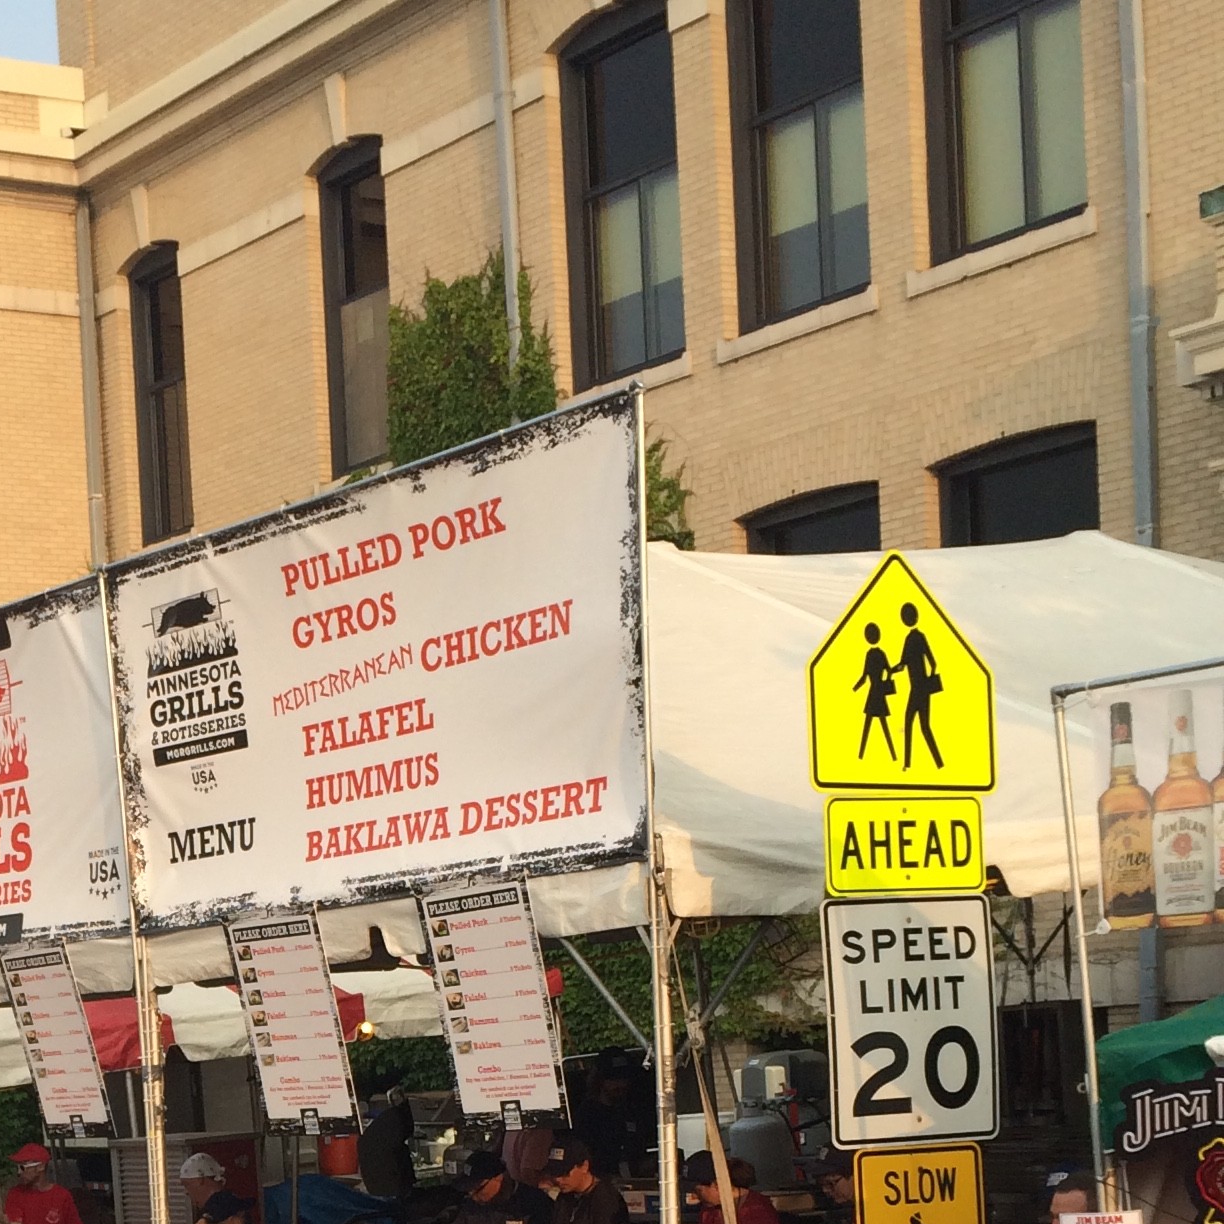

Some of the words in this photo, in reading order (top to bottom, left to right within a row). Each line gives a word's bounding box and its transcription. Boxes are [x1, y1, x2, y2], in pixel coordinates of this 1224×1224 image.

[281, 532, 403, 597] PULLED
[408, 497, 507, 559] PORK
[292, 592, 397, 649] GYROS
[146, 659, 241, 699] MINNESOTA
[272, 643, 414, 717] MEDITERRANEAN
[420, 599, 574, 673] CHICKEN
[150, 681, 245, 728] GRILLS
[151, 731, 159, 746] &
[161, 712, 247, 745] ROTISSERIES
[166, 736, 235, 761] MGRGRILLS.COM
[302, 698, 434, 757] FALAFEL
[192, 769, 216, 785] USA
[306, 752, 440, 810] HUMMUS
[168, 817, 256, 864] MENU
[305, 807, 451, 862] BAKLAWA
[459, 776, 608, 836] DESSERT
[840, 819, 972, 870] AHEAD
[89, 858, 120, 884] USA
[428, 900, 461, 915] PLEASE
[461, 894, 493, 909] ORDER
[492, 890, 516, 905] HERE
[233, 929, 261, 941] PLEASE
[261, 925, 288, 937] ORDER
[288, 922, 309, 934] HERE
[842, 925, 976, 965] SPEED
[860, 975, 964, 1015] LIMIT
[851, 1025, 980, 1118] 20
[1123, 1088, 1212, 1153] JIM
[884, 1166, 957, 1206] SLOW
[1076, 1216, 1092, 1224] JIM
[1095, 1215, 1124, 1224] BEAM
